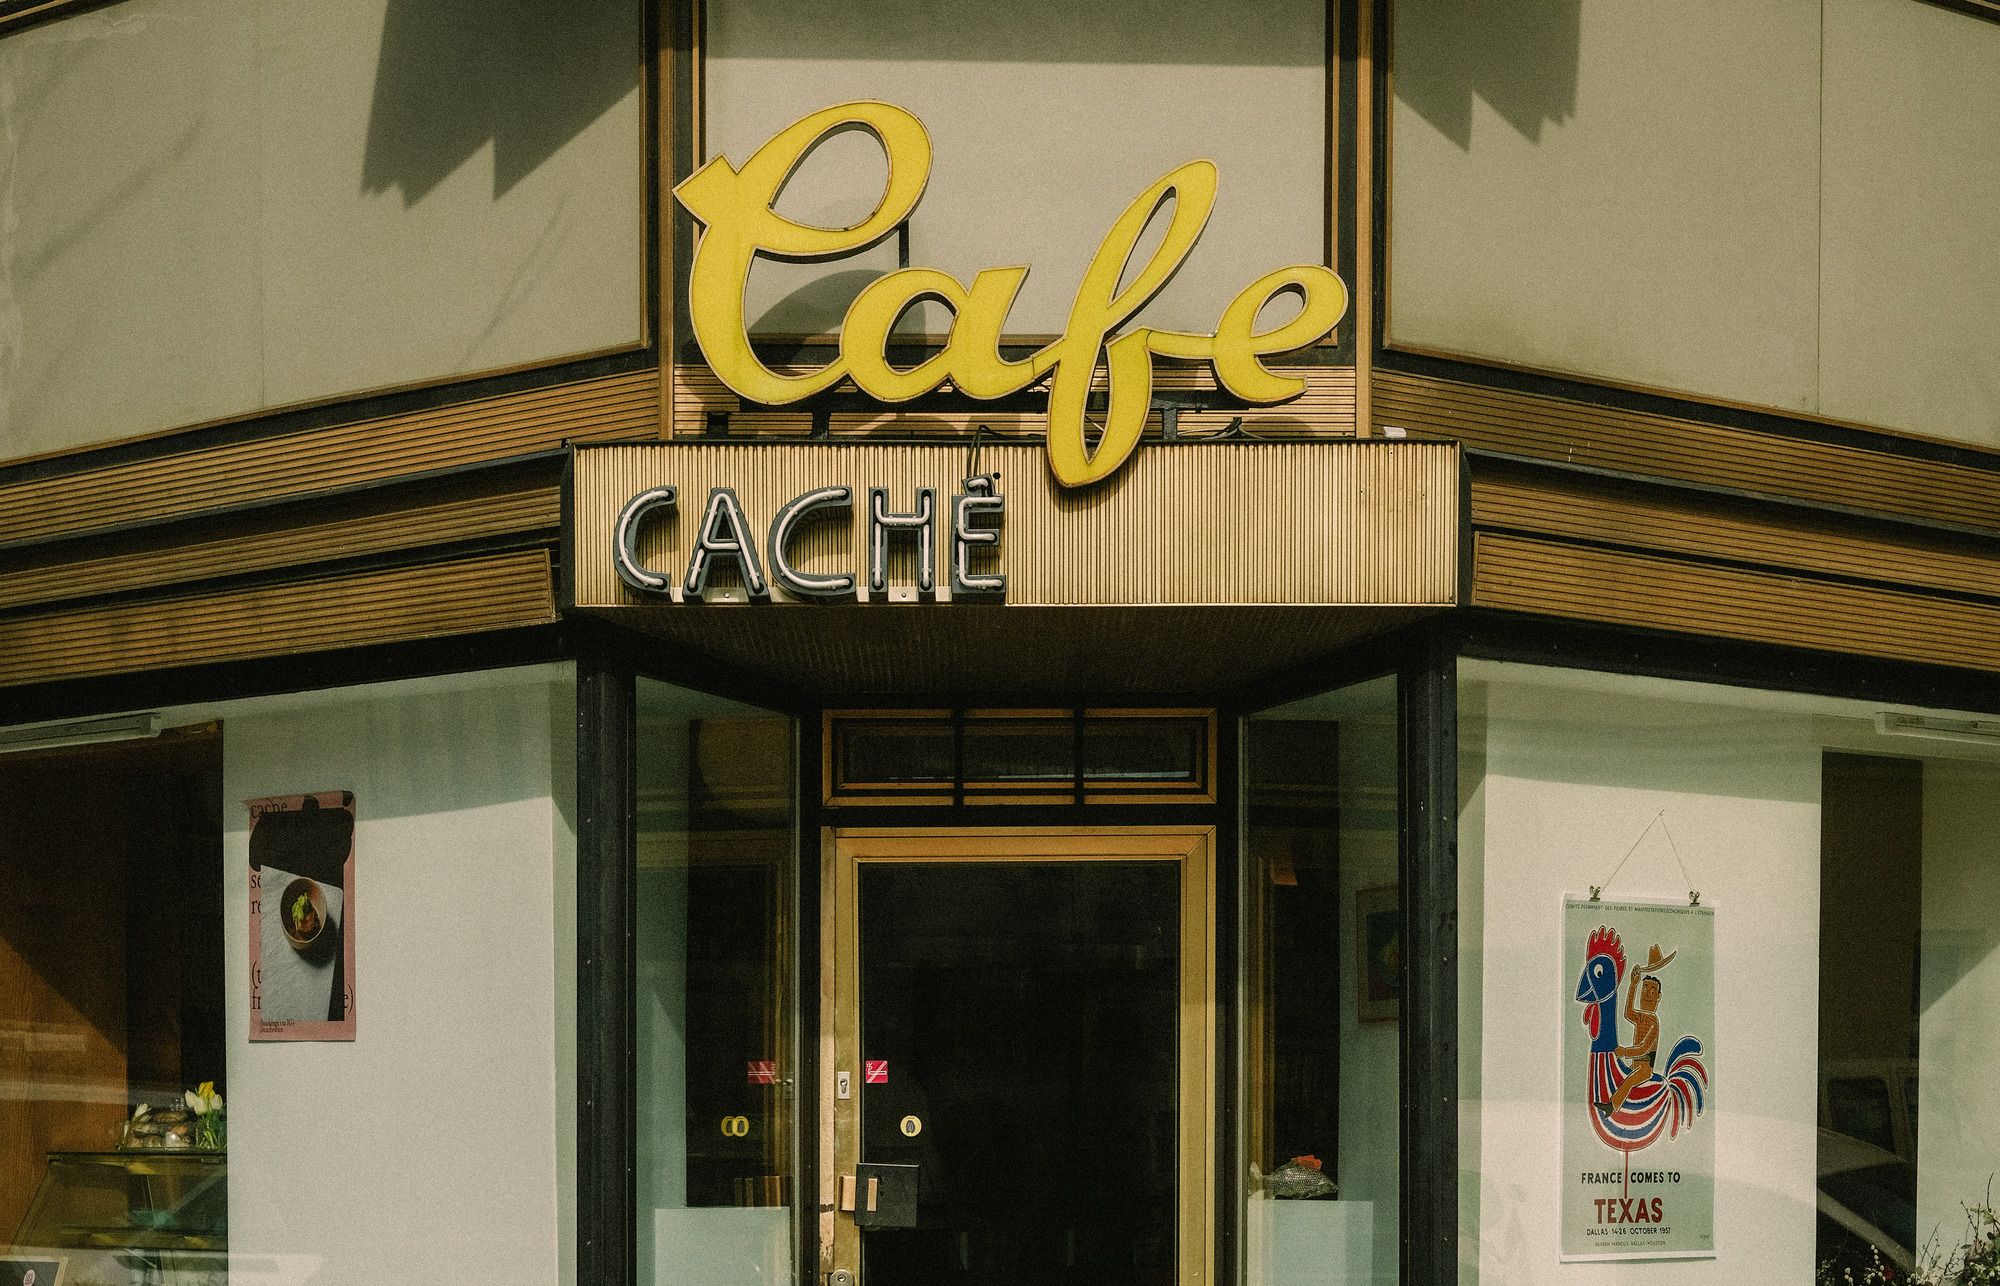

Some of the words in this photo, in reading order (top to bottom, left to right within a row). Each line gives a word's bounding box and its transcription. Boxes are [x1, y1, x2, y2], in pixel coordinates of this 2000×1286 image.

[673, 99, 1349, 487] Cafe
[613, 473, 1006, 599] CACHÉ
[1581, 1172, 1622, 1184] FRANCE
[1630, 1171, 1664, 1184] COMES
[1667, 1171, 1681, 1184] TO
[1594, 1197, 1663, 1224] TEXAS
[1586, 1228, 1609, 1236] DALLAS
[1629, 1227, 1658, 1235] OCTOBER
